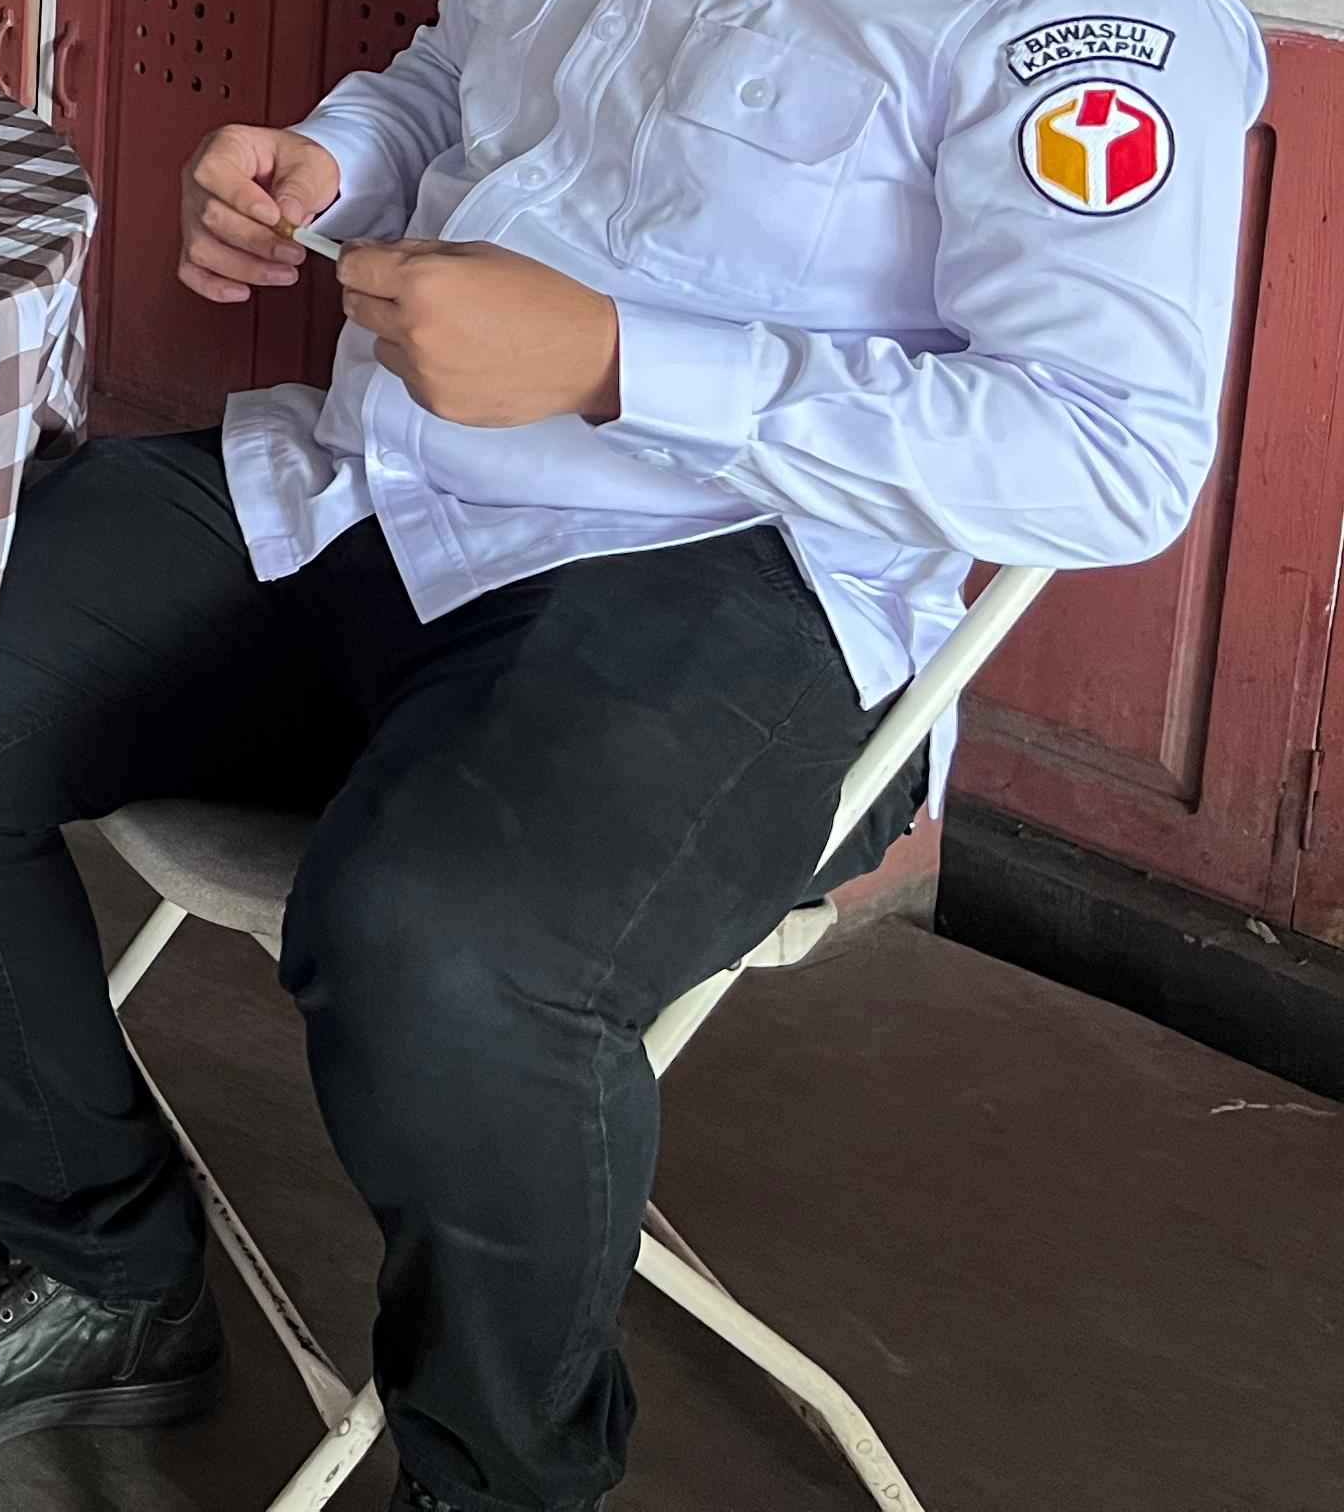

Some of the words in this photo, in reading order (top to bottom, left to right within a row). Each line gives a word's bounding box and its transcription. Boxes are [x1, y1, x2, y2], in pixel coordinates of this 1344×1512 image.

[1025, 23, 1147, 54] BAWASLU
[1023, 46, 1081, 73] KAB.
[1084, 41, 1154, 61] TAPIN
